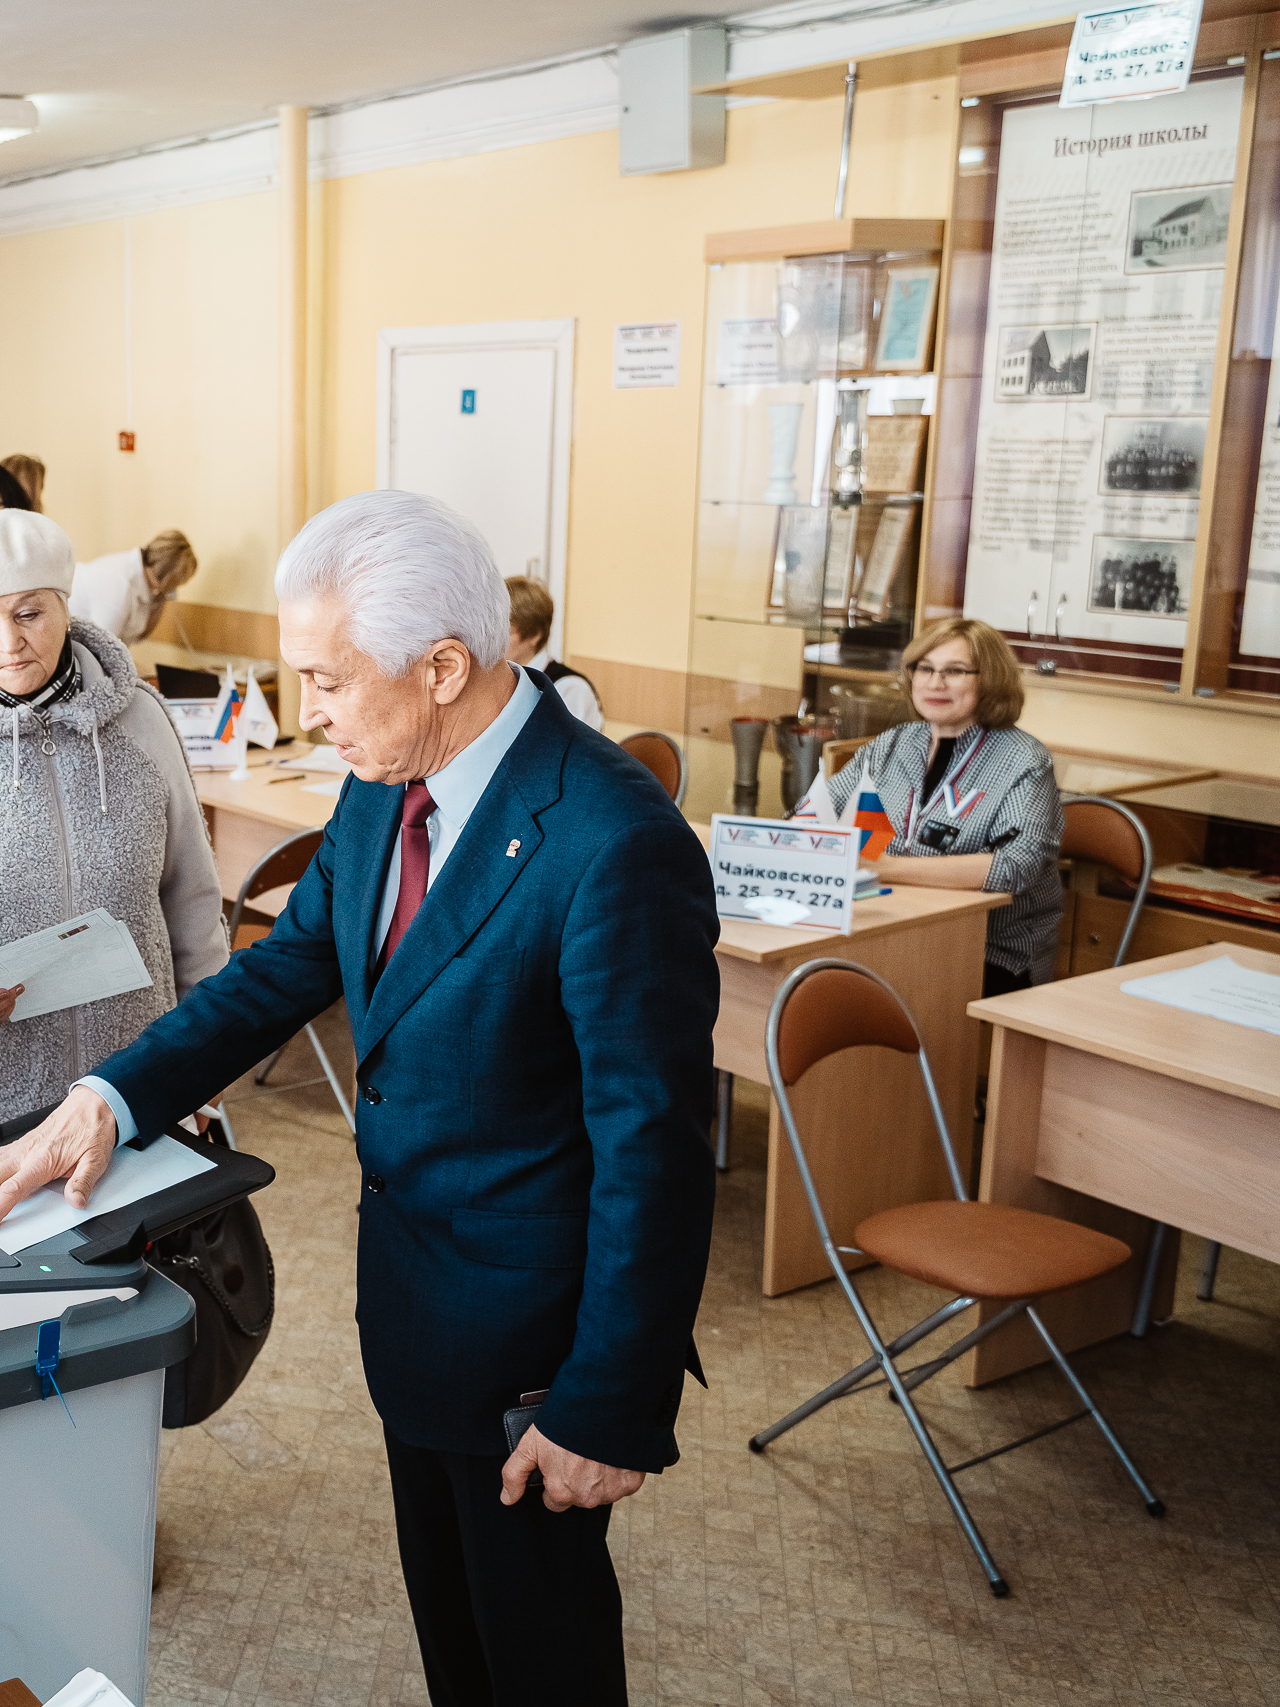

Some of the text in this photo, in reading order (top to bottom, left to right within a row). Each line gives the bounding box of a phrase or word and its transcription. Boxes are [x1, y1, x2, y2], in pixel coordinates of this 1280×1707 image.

[1079, 41, 1188, 64] Чайковскоо
[1094, 68, 1117, 82] 25,
[1124, 63, 1148, 77] 27,
[1154, 60, 1185, 74] 27а
[1053, 122, 1209, 159] История школы
[718, 861, 846, 887] Чайковского
[809, 892, 844, 909] 27а
